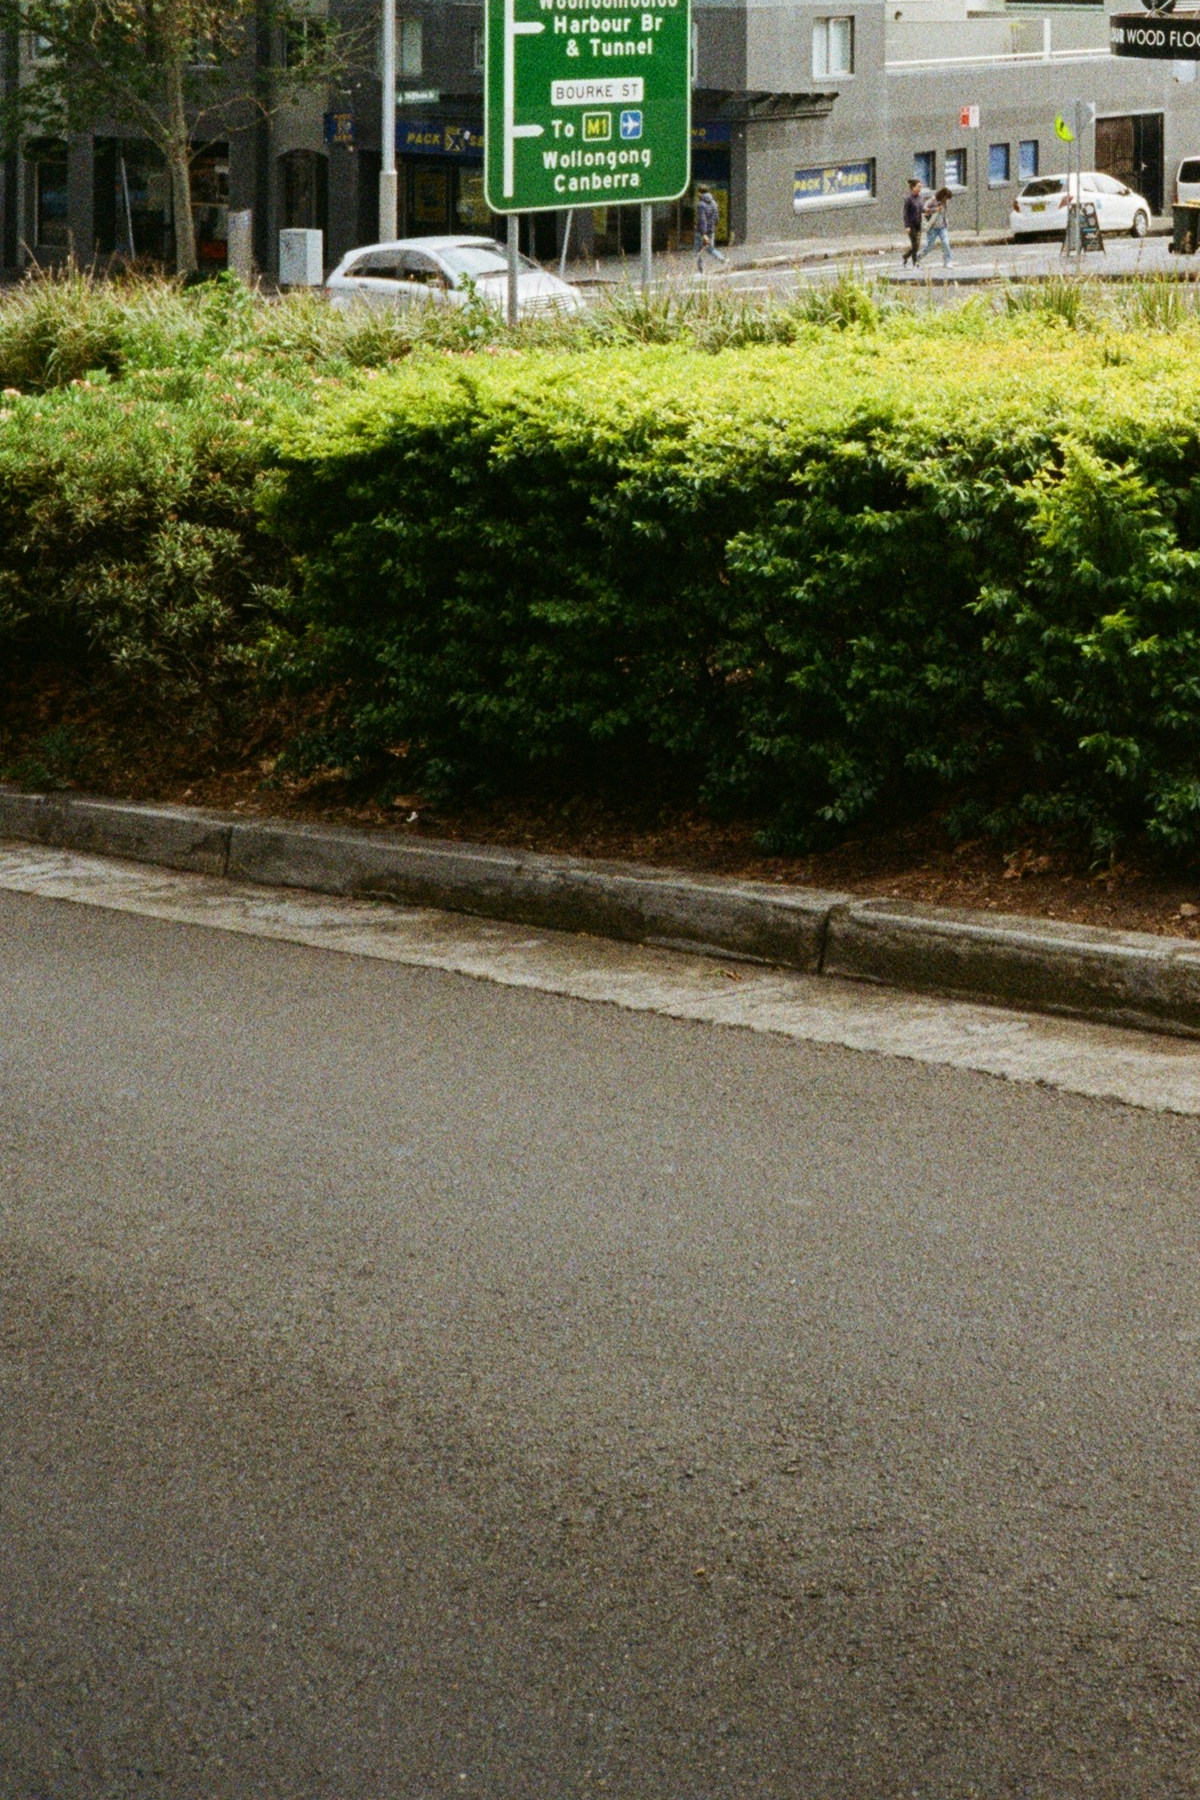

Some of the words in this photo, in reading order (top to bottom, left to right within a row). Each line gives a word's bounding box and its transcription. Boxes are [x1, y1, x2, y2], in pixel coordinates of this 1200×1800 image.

[553, 15, 631, 34] Harbour
[640, 13, 663, 32] Br
[566, 38, 580, 57] &
[589, 37, 653, 57] Tunnel
[1126, 29, 1166, 46] WOOD
[556, 84, 614, 100] BOURKE
[621, 83, 639, 97] ST
[406, 131, 440, 145] PACK
[551, 119, 575, 138] To
[586, 119, 608, 136] M1
[542, 148, 651, 170] Wollongong
[554, 172, 640, 193] Canberra
